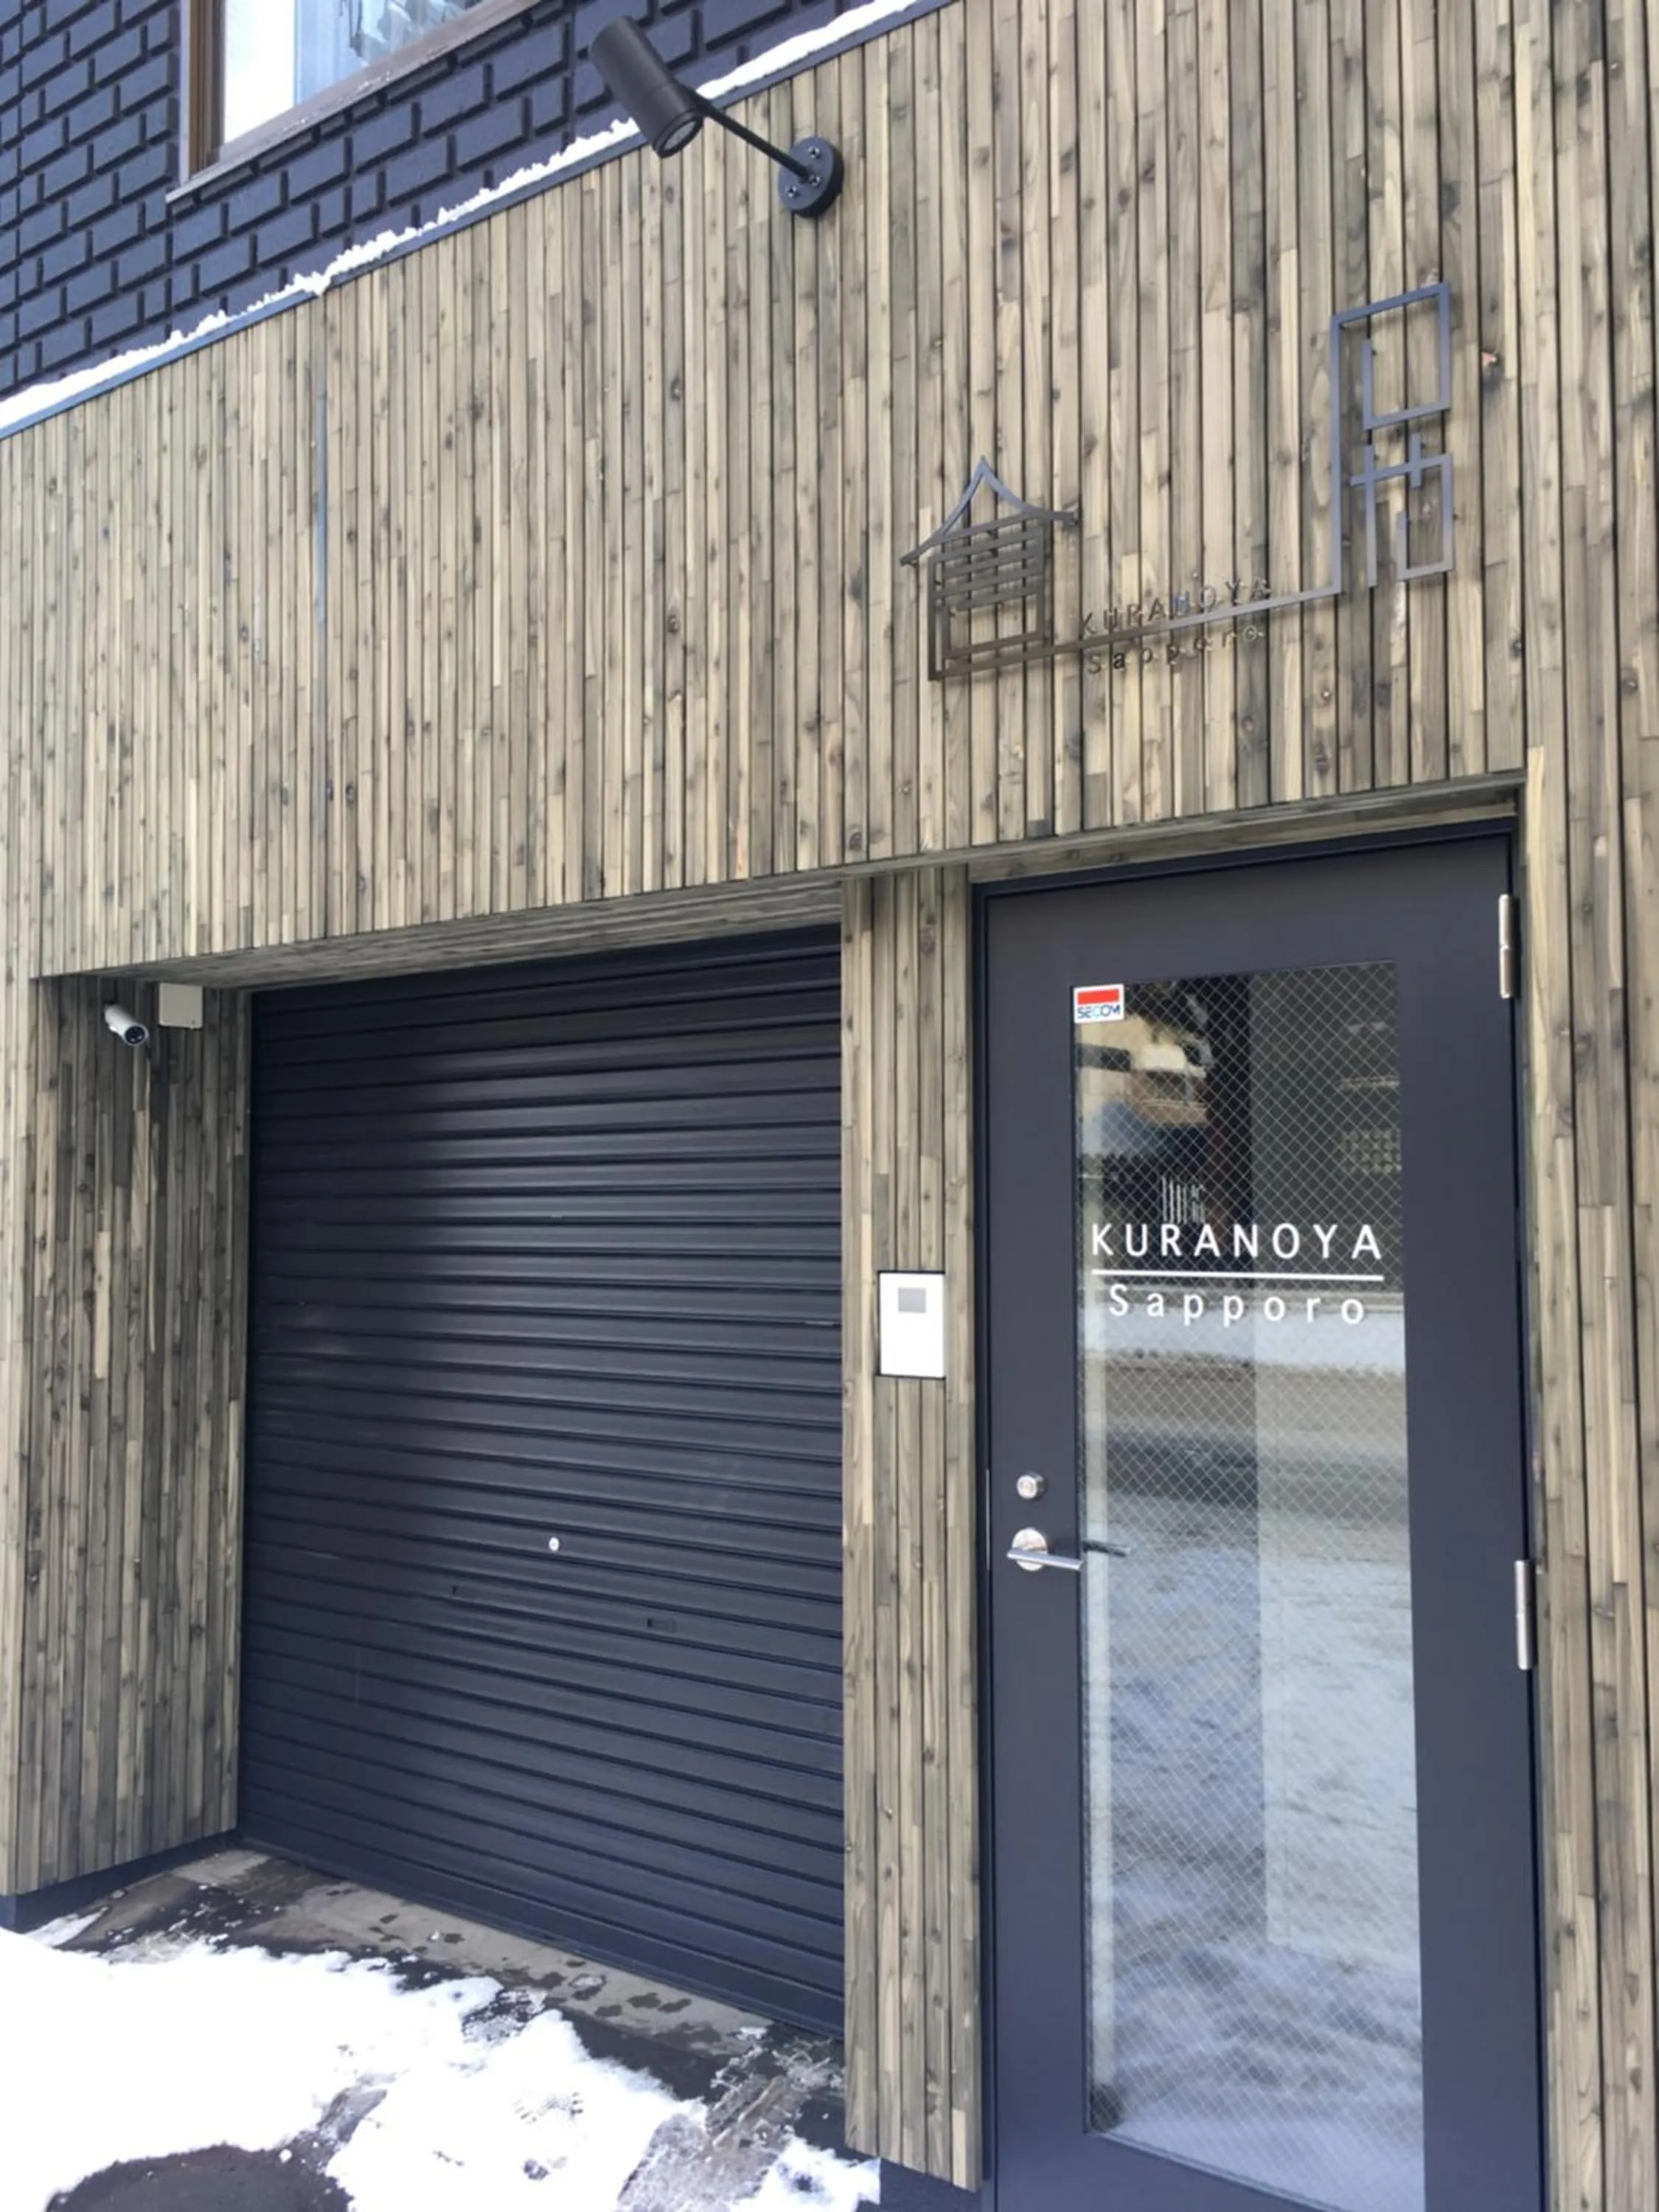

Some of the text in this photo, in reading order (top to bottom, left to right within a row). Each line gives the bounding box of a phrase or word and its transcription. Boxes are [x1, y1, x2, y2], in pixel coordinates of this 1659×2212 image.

[1081, 577, 1269, 635] KURANOYA
[1077, 1004, 1120, 1019] SECOM
[1091, 1223, 1382, 1259] KURANOYA
[1109, 1283, 1366, 1326] Sapporo
